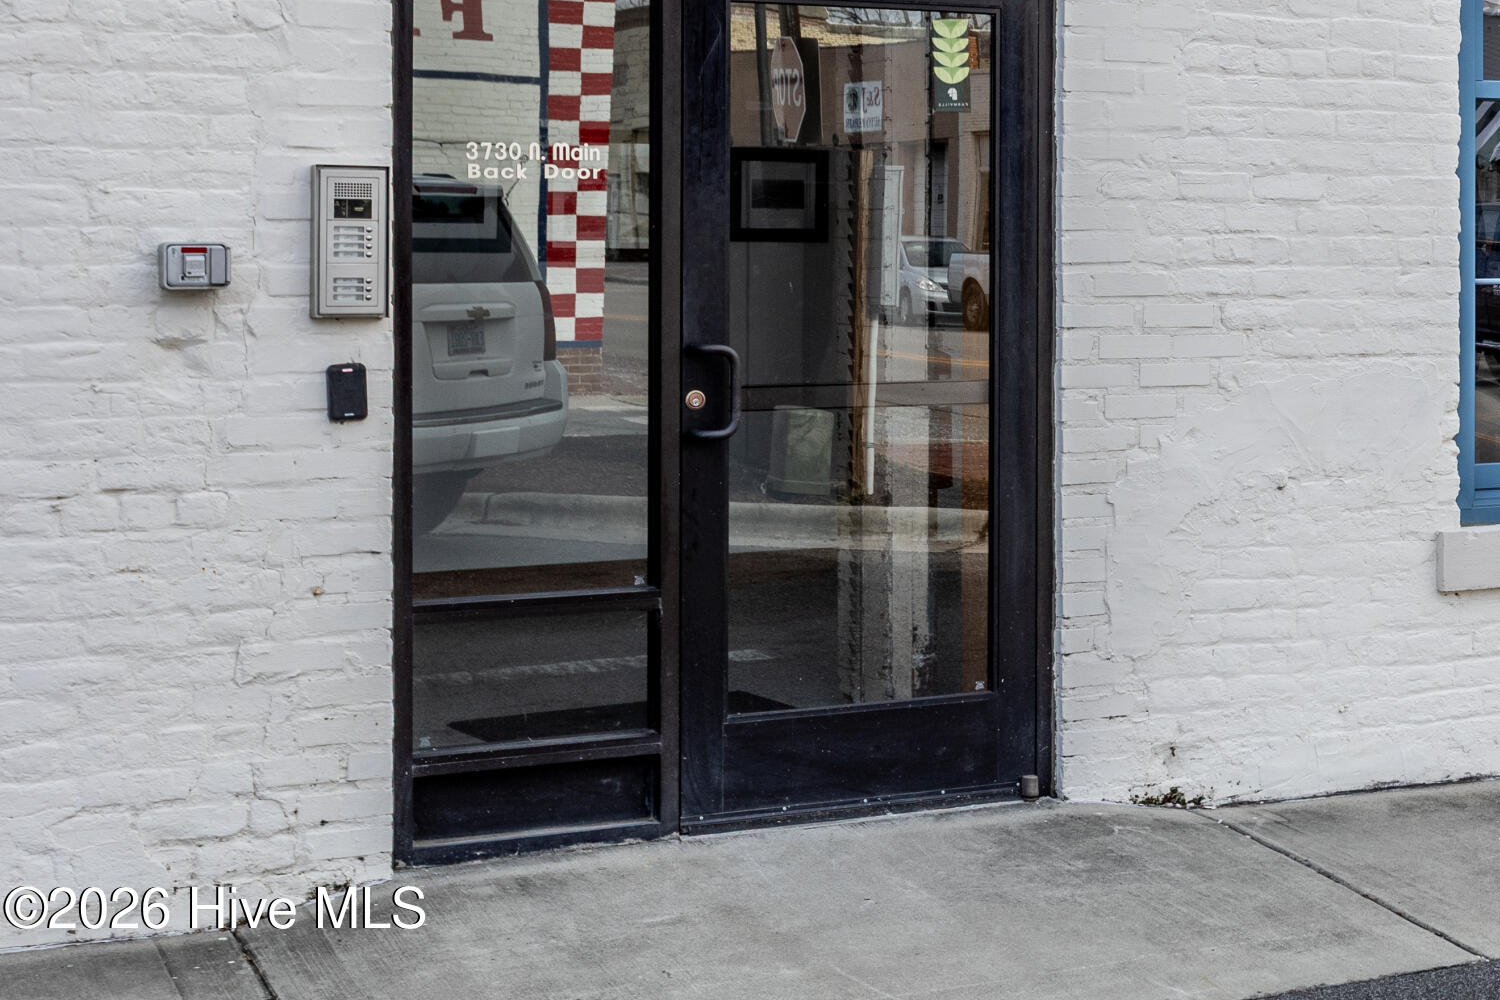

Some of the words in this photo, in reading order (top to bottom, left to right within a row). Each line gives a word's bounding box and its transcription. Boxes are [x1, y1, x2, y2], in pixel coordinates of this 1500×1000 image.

[465, 141, 522, 161] 3730
[528, 142, 547, 161] N.
[551, 142, 601, 161] Main
[466, 162, 528, 180] Back
[543, 163, 602, 180] Door
